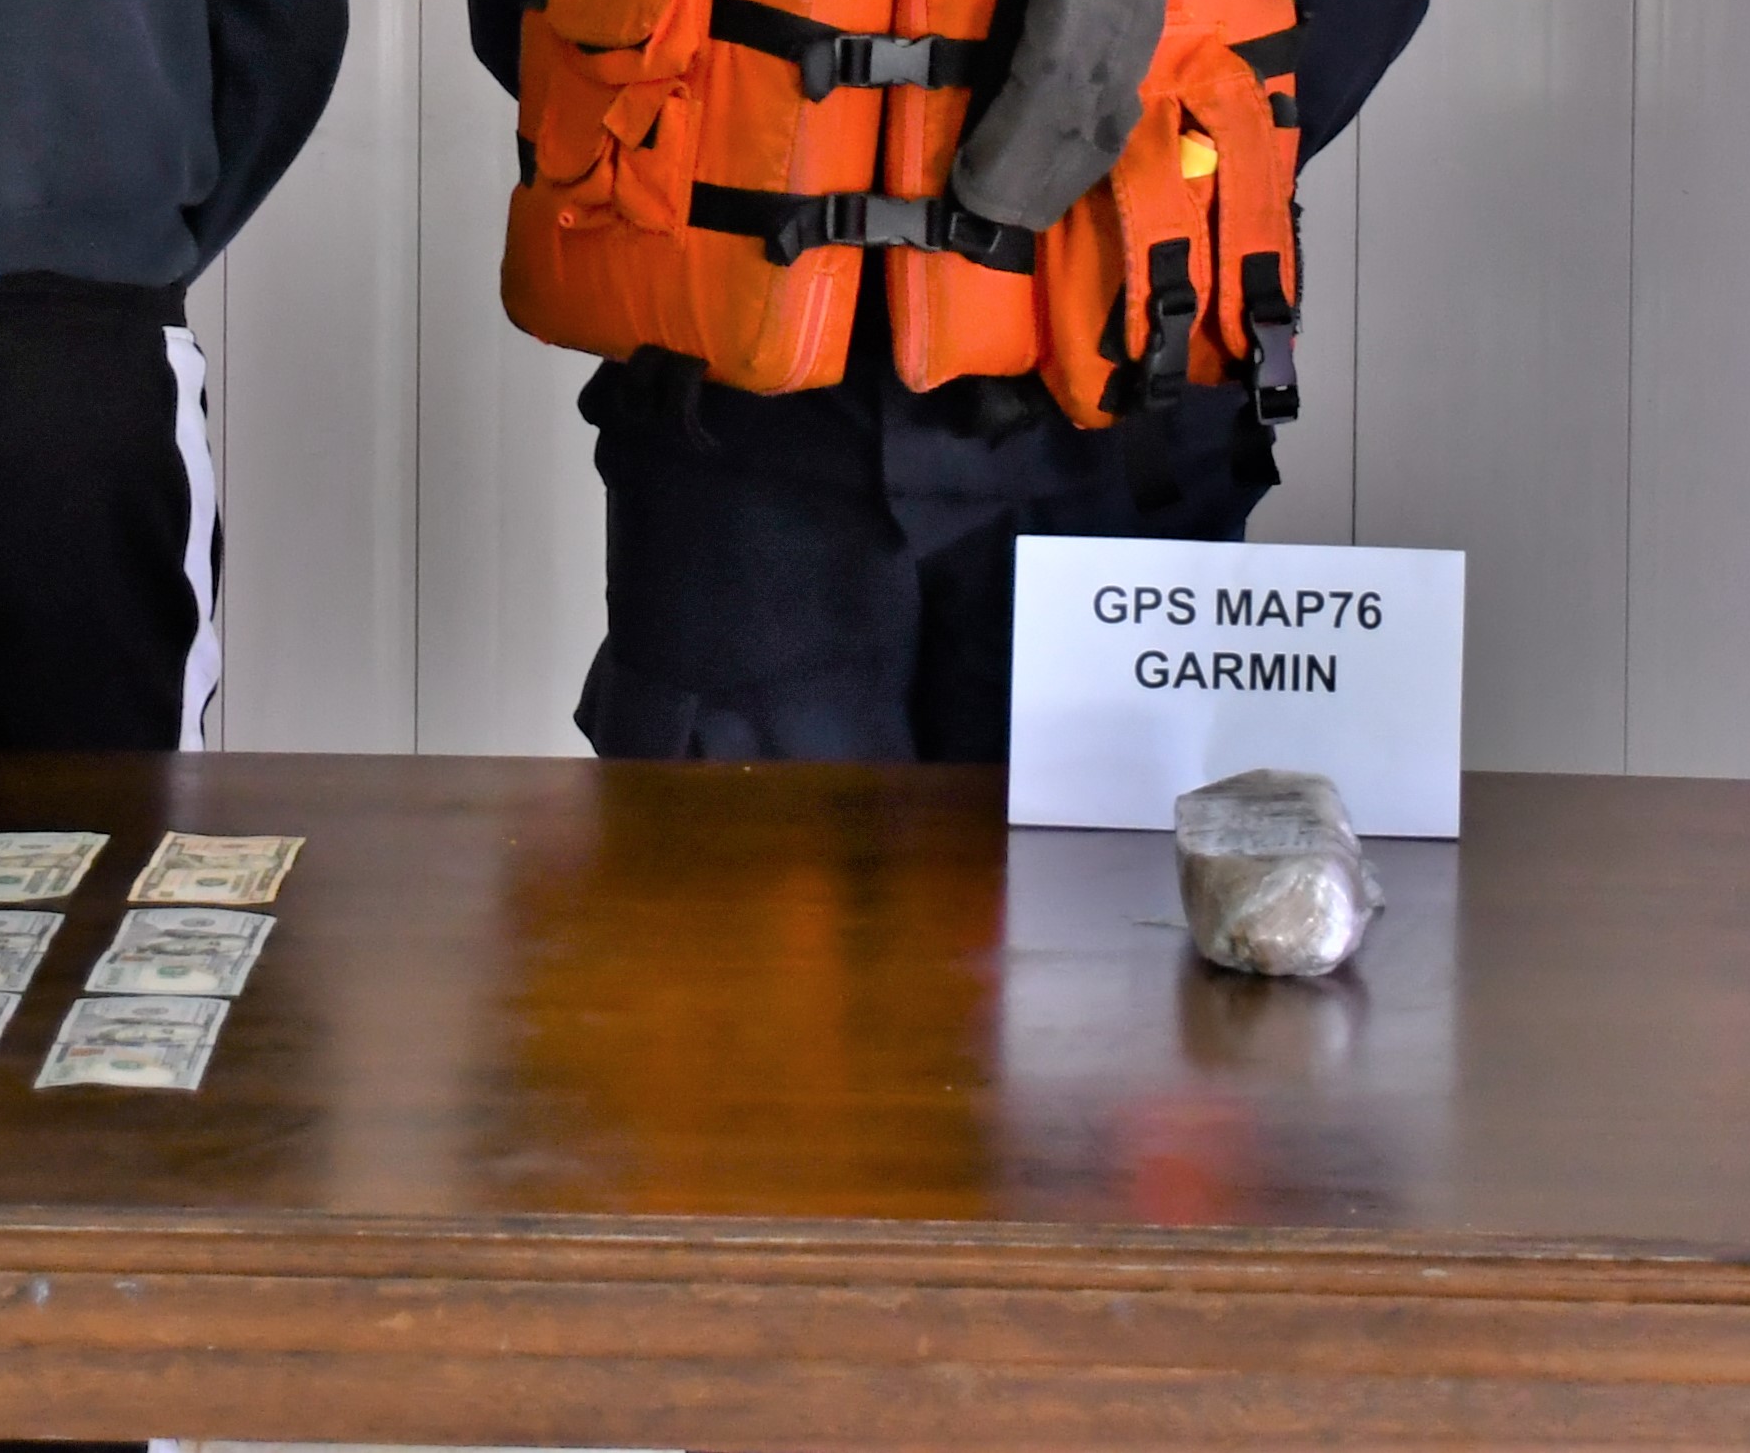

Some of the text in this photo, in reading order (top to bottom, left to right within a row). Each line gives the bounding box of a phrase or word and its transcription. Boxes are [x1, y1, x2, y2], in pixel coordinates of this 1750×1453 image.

[1093, 586, 1382, 630] GPS MAP76
[1134, 650, 1338, 693] GARMIN
